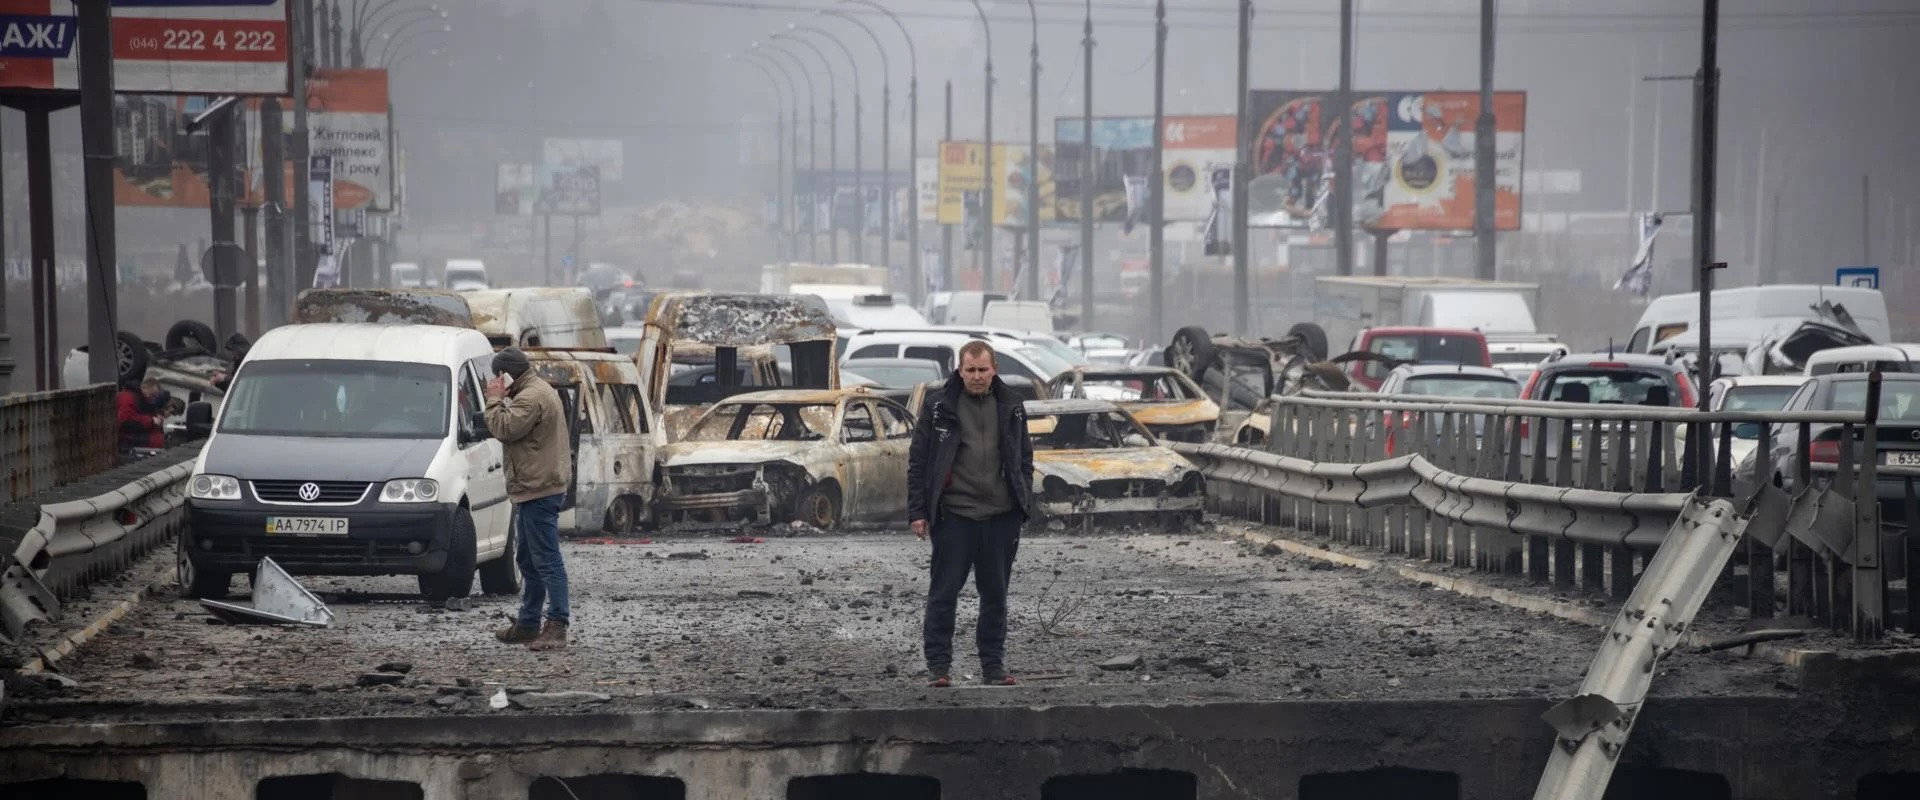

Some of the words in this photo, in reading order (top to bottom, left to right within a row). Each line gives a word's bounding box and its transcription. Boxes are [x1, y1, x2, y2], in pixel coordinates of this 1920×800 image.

[129, 37, 158, 50] (044)
[163, 30, 206, 50] 222
[213, 30, 226, 51] 4
[234, 30, 276, 51] 222
[349, 164, 381, 176] року
[275, 519, 293, 531] AA
[296, 519, 325, 531] 7974
